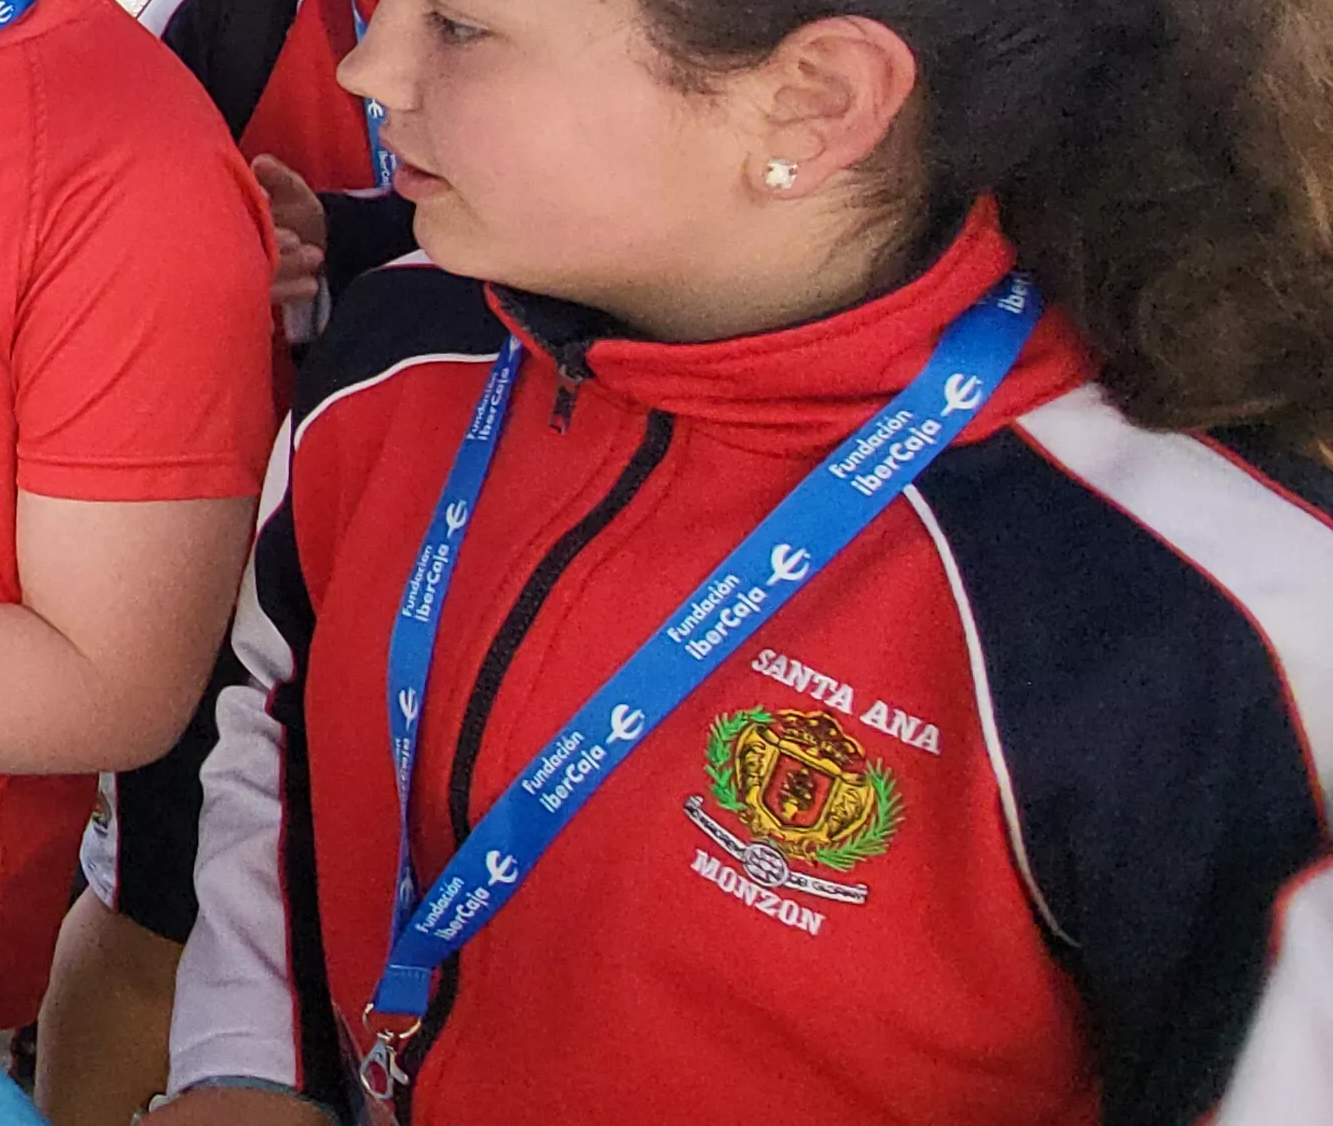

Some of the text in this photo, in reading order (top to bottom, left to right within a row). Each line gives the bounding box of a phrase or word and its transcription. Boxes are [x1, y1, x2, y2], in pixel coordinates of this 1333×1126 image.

[829, 409, 914, 478] Fundación
[402, 544, 433, 617] Fundación
[667, 574, 740, 644] Fundación
[751, 649, 942, 755] SANTA ANA
[522, 731, 585, 795] Fundación
[416, 876, 465, 934] Fundación
[691, 849, 827, 936] MONZON
